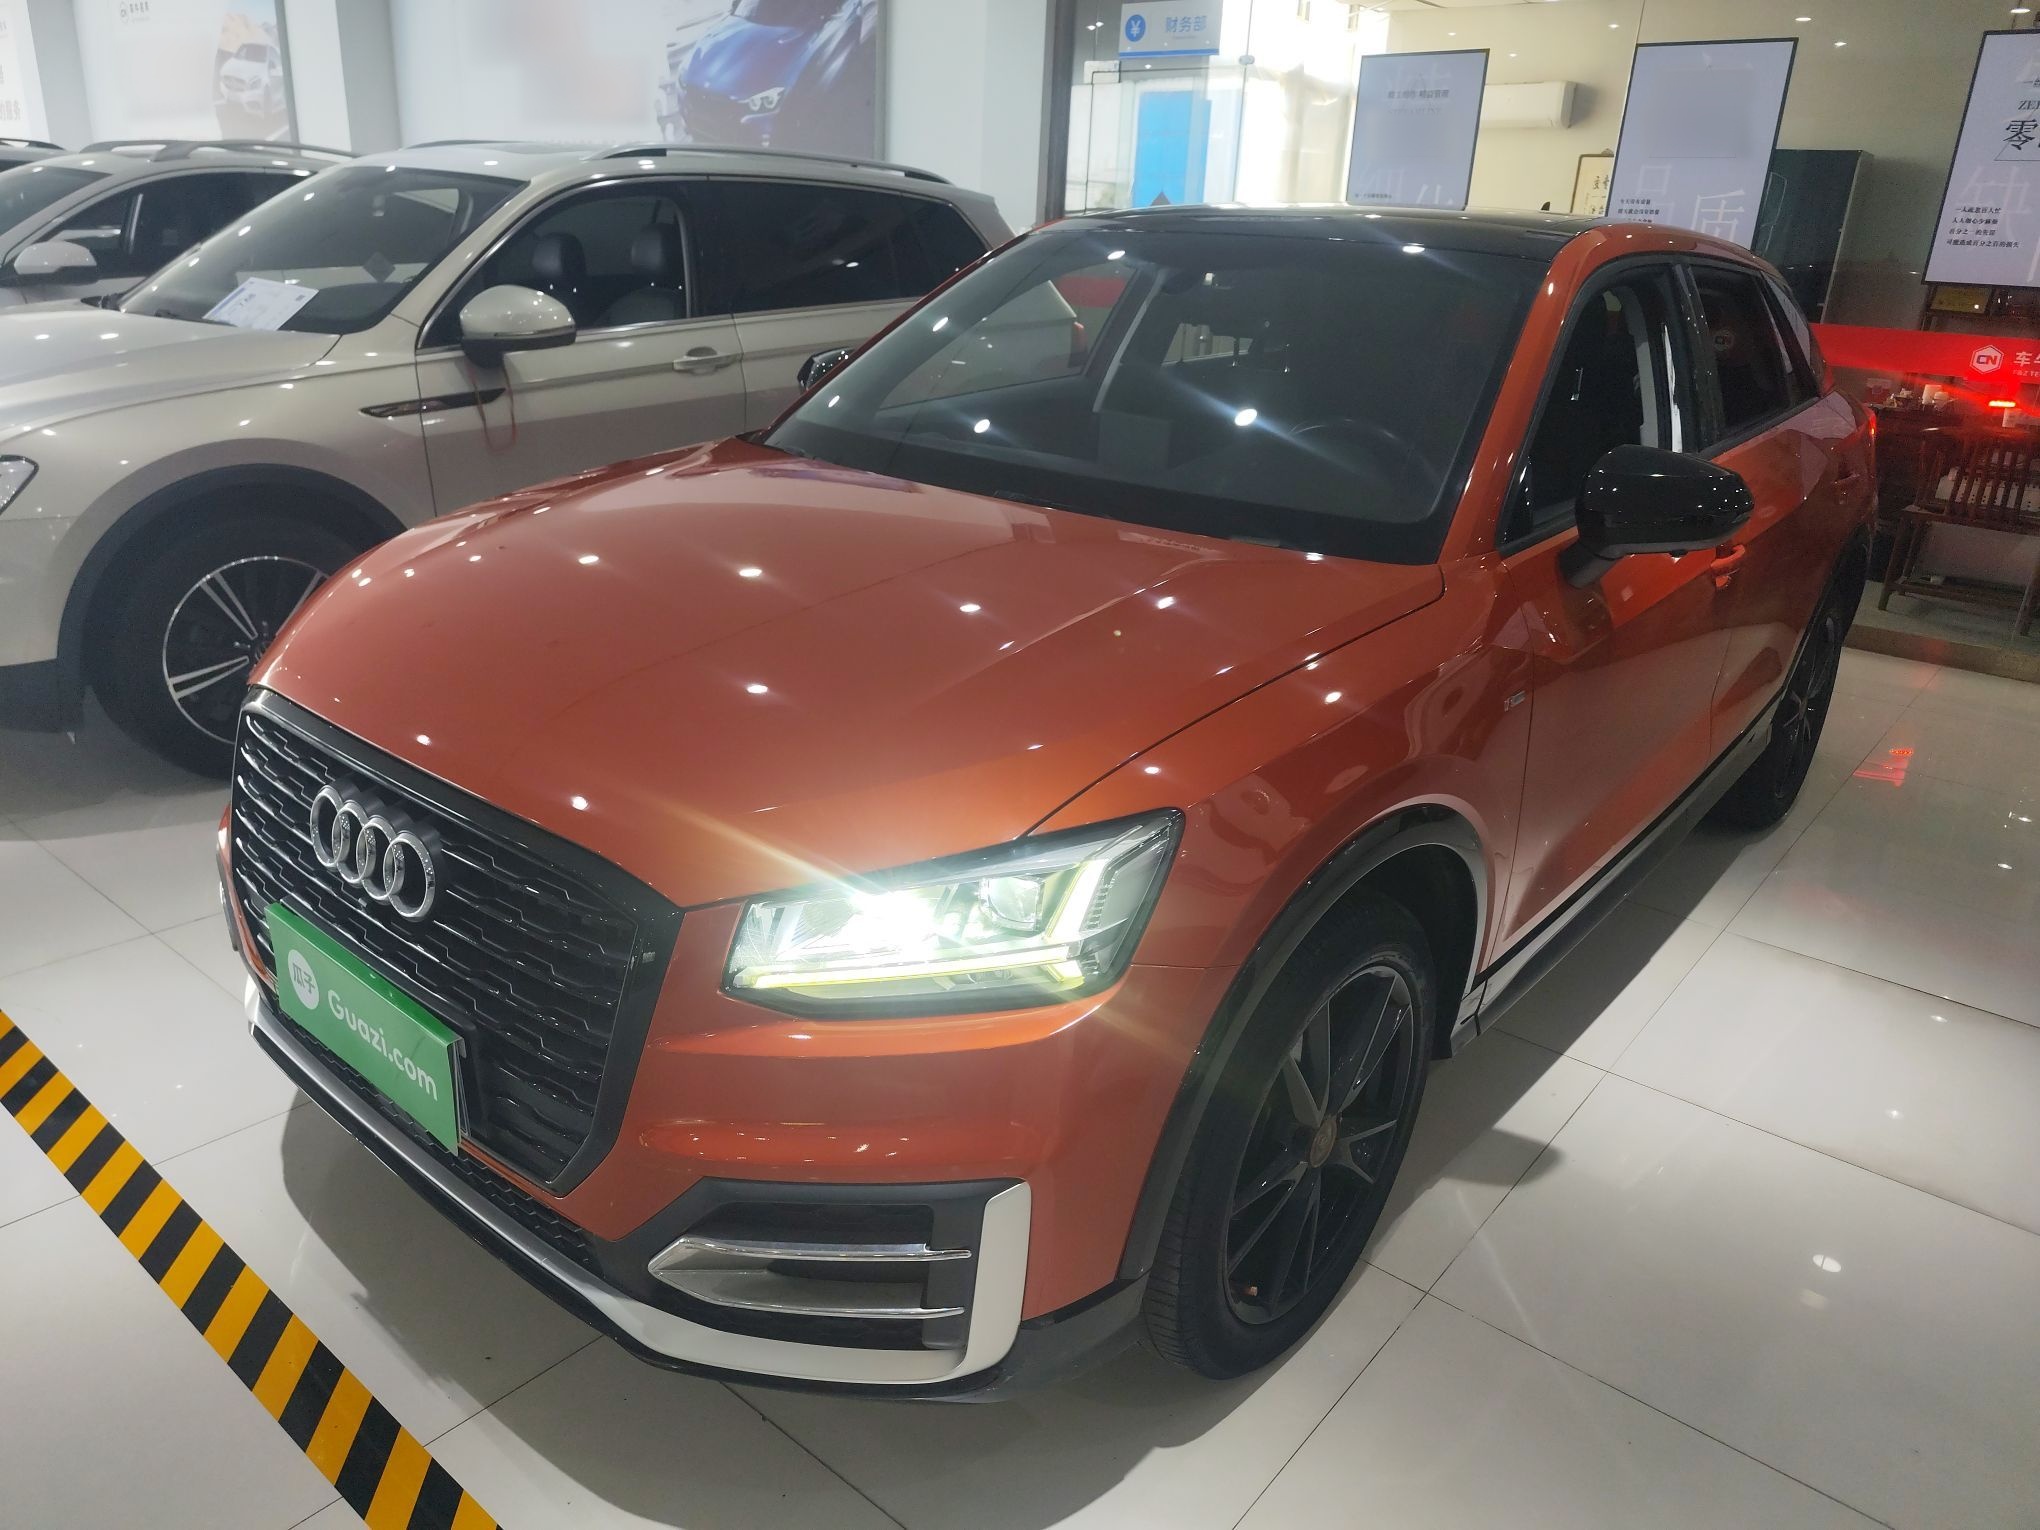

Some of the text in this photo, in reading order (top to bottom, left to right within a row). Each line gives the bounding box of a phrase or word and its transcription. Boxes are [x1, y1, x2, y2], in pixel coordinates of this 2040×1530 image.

[1166, 15, 1207, 33] 财务部
[2003, 119, 2040, 151] 零
[1976, 354, 1998, 366] CN
[292, 962, 316, 994] 瓜子
[328, 989, 438, 1101] Guazi.com
